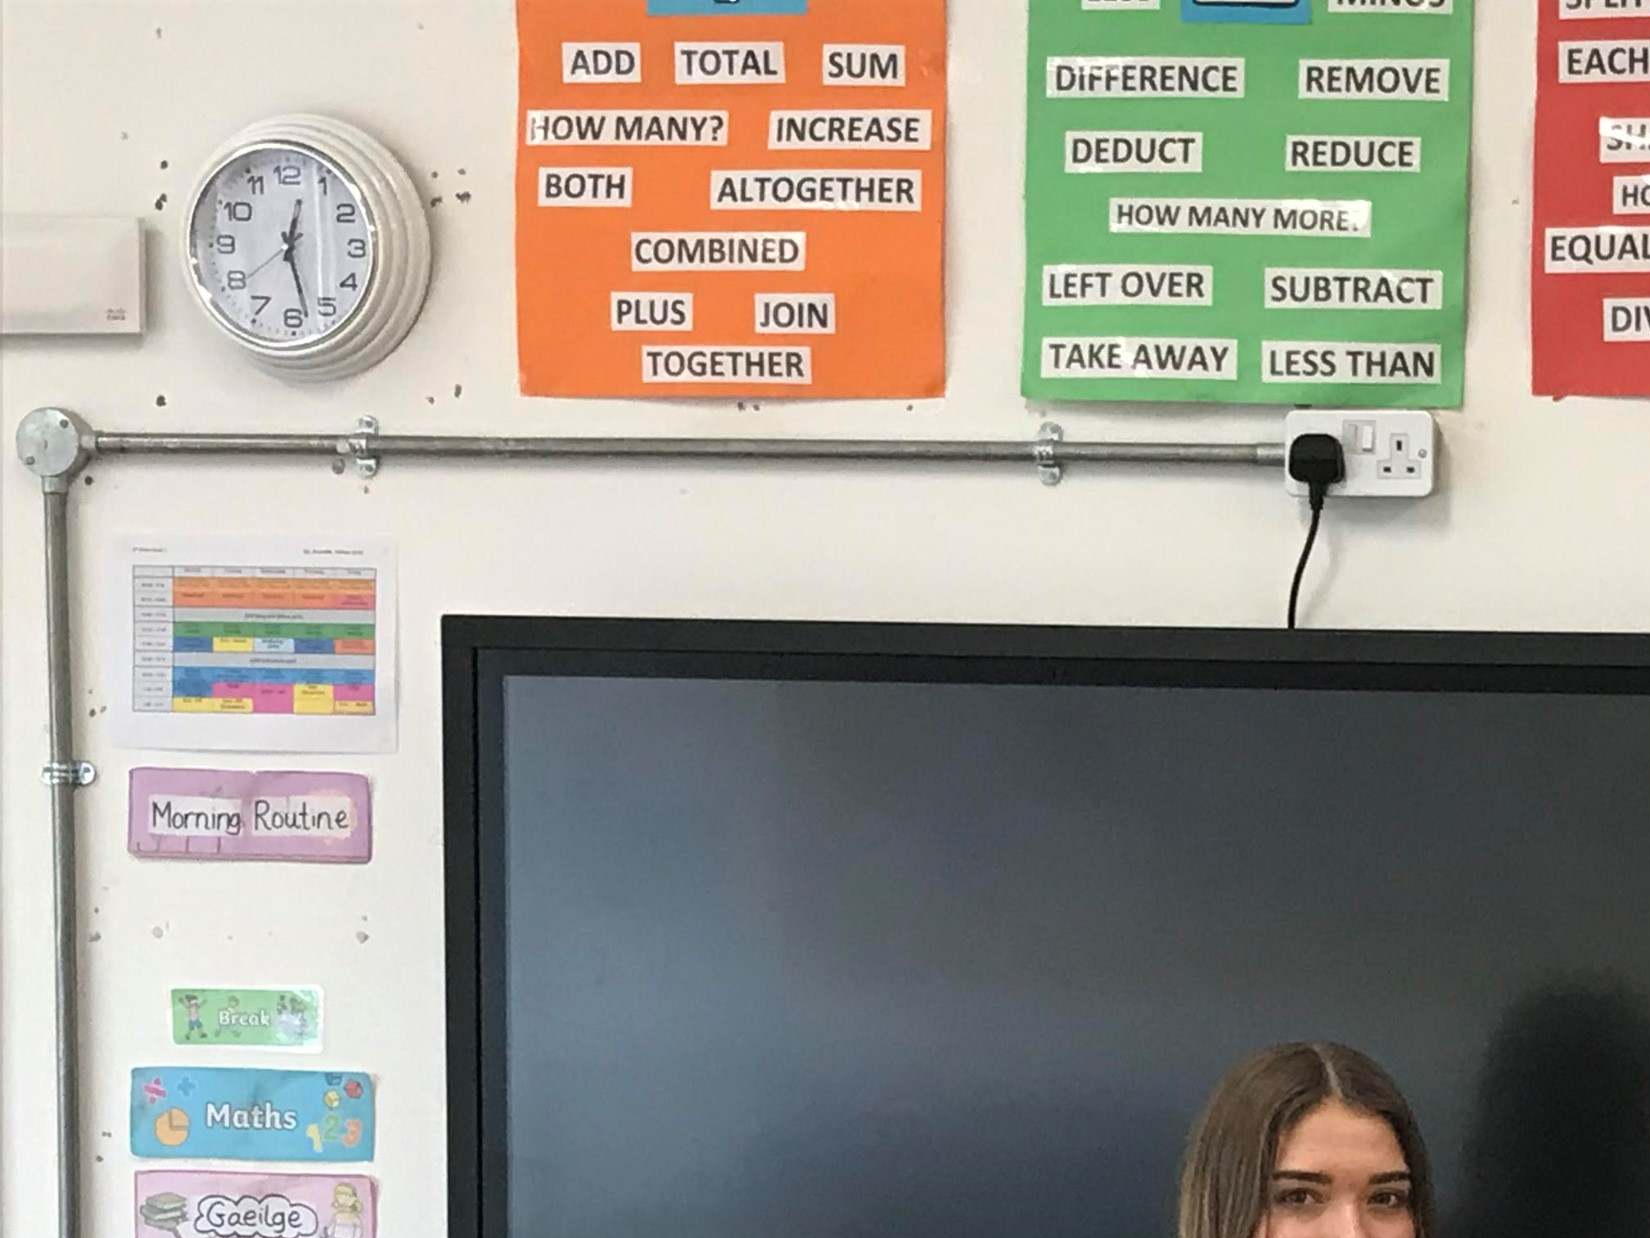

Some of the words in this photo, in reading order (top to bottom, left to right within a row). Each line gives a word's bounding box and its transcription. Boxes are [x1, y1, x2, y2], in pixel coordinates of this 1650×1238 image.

[570, 49, 636, 77] ADD
[680, 49, 778, 77] TOTAL
[827, 52, 898, 80] SUM
[1566, 47, 1650, 75] EACH
[1055, 66, 1238, 92] DIFFERENCE
[1305, 66, 1441, 94] REMOVE
[530, 116, 606, 141] HOW
[614, 116, 724, 141] MANY?
[776, 117, 920, 143] INCREASE
[1071, 138, 1195, 163] DEDUCT
[1291, 141, 1414, 167] REDUCE
[247, 175, 264, 195] 11
[273, 165, 301, 185] 12
[318, 177, 327, 196] 1
[545, 173, 626, 199] BOTH
[717, 177, 915, 203] ALTOGETHER
[224, 202, 252, 221] 10
[336, 204, 356, 223] 2
[1117, 205, 1180, 226] HOW
[1188, 206, 1266, 229] MANY
[217, 235, 235, 254] 9
[347, 239, 366, 258] 3
[634, 238, 800, 265] COMBINED
[227, 270, 246, 290] 8
[339, 273, 358, 291] 4
[1048, 272, 1112, 298] LEFT
[1120, 273, 1205, 298] OVER
[1270, 276, 1434, 304] SUBTRACT
[250, 295, 271, 315] 7
[283, 308, 303, 328] 6
[317, 297, 336, 316] 5
[616, 299, 687, 325] PLUS
[759, 302, 829, 328] JOIN
[647, 351, 805, 377] TOGETHER
[1049, 344, 1123, 369] TAKE
[1131, 345, 1230, 372] AWAY
[1270, 349, 1337, 377] LESS
[1346, 351, 1435, 377] THAN
[152, 800, 242, 836] Morning
[254, 800, 350, 830] Routine
[218, 1010, 270, 1027] Break
[206, 1102, 297, 1130] Maths
[206, 1201, 303, 1235] Gaeilge
